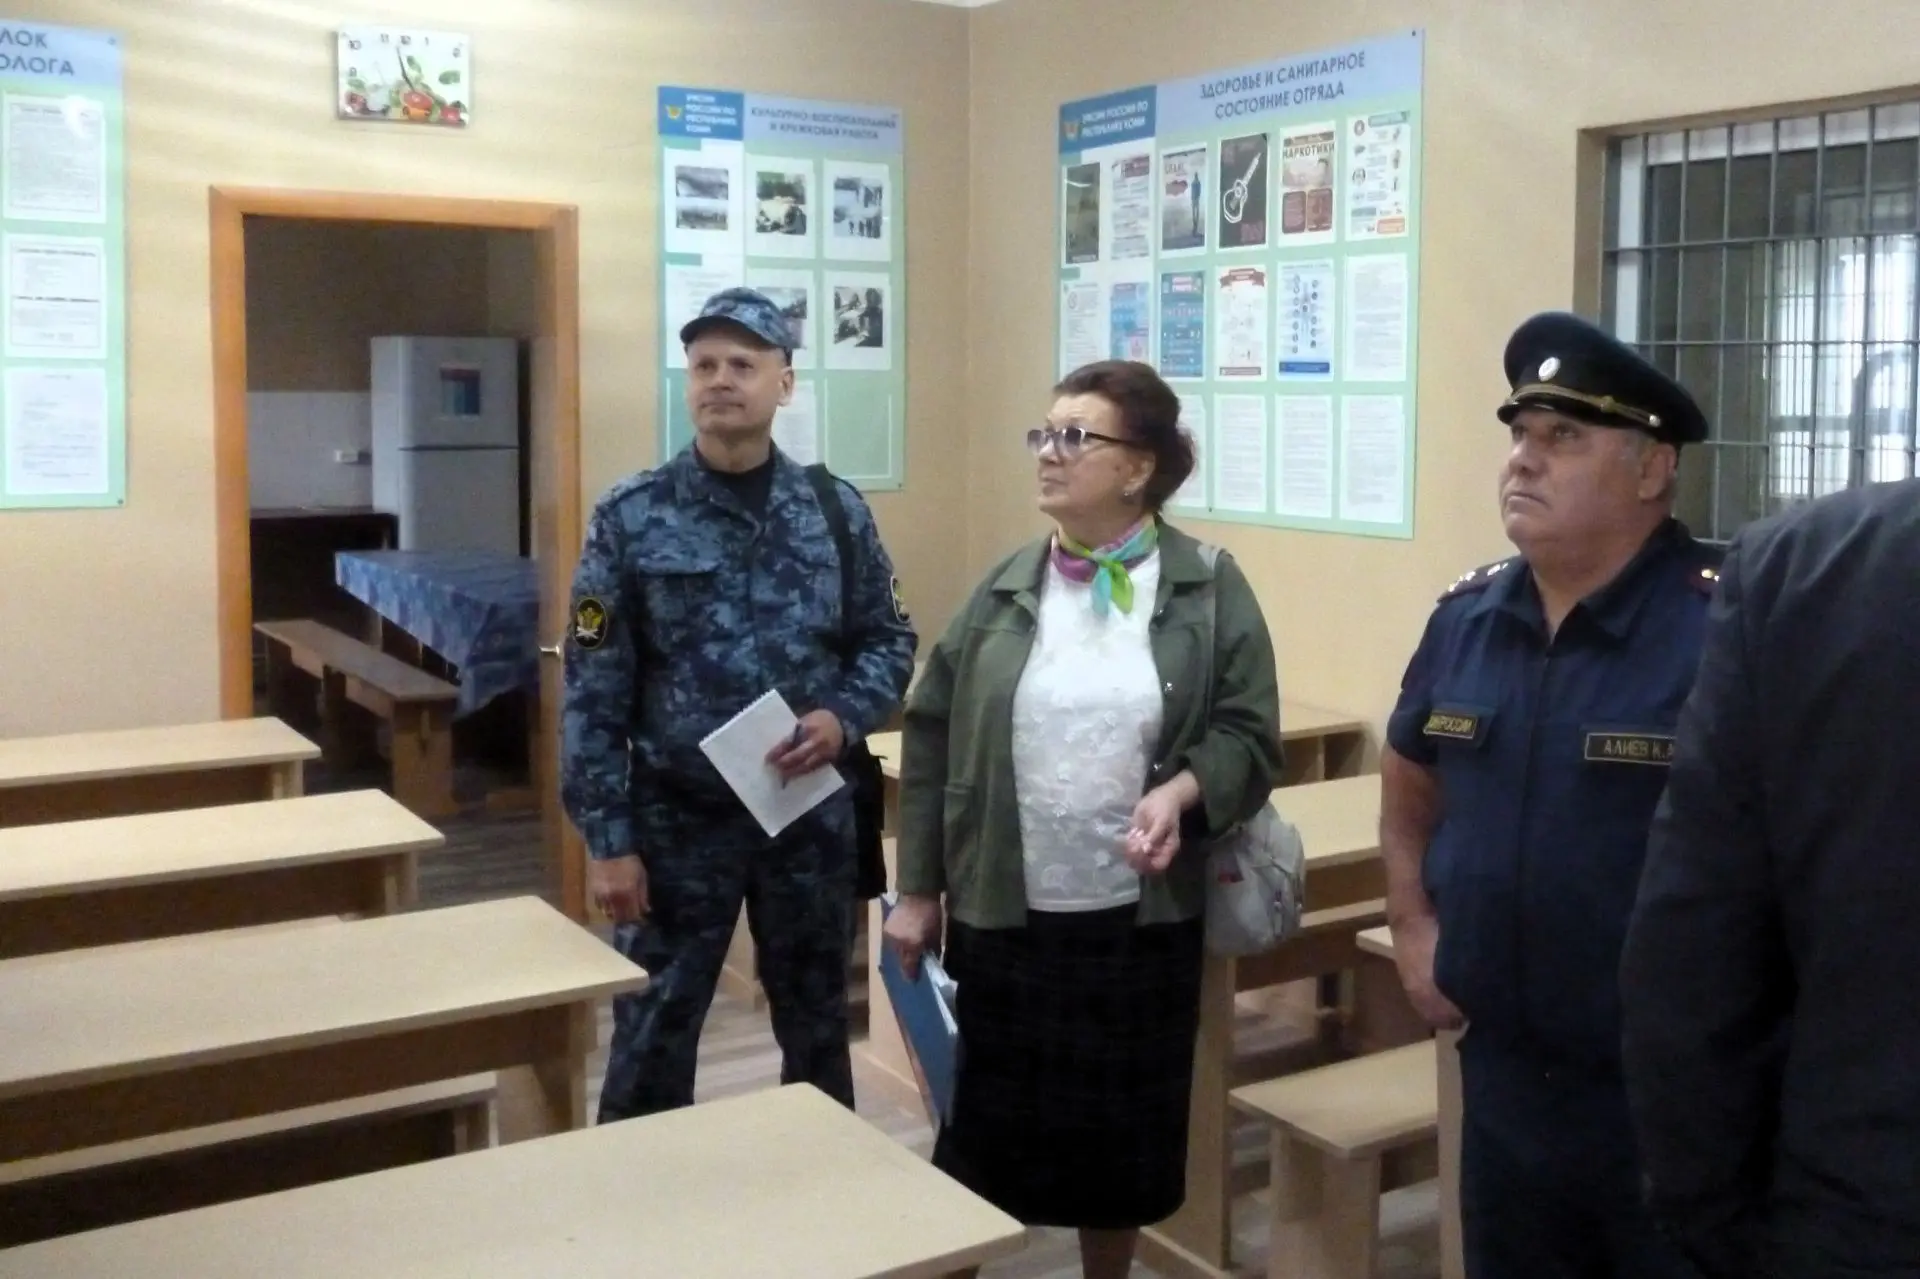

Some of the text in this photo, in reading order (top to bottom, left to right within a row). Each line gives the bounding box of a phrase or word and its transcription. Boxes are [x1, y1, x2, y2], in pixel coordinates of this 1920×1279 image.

[1200, 51, 1366, 99] ЗДОРОВЬЕ И САНИТАРНОЕ
[1215, 80, 1345, 119] СОСТОЯНИЕ ОТРЯДА
[1283, 143, 1335, 159] НАРКОТИКИ
[1604, 739, 1649, 757] АЛИЕВ
